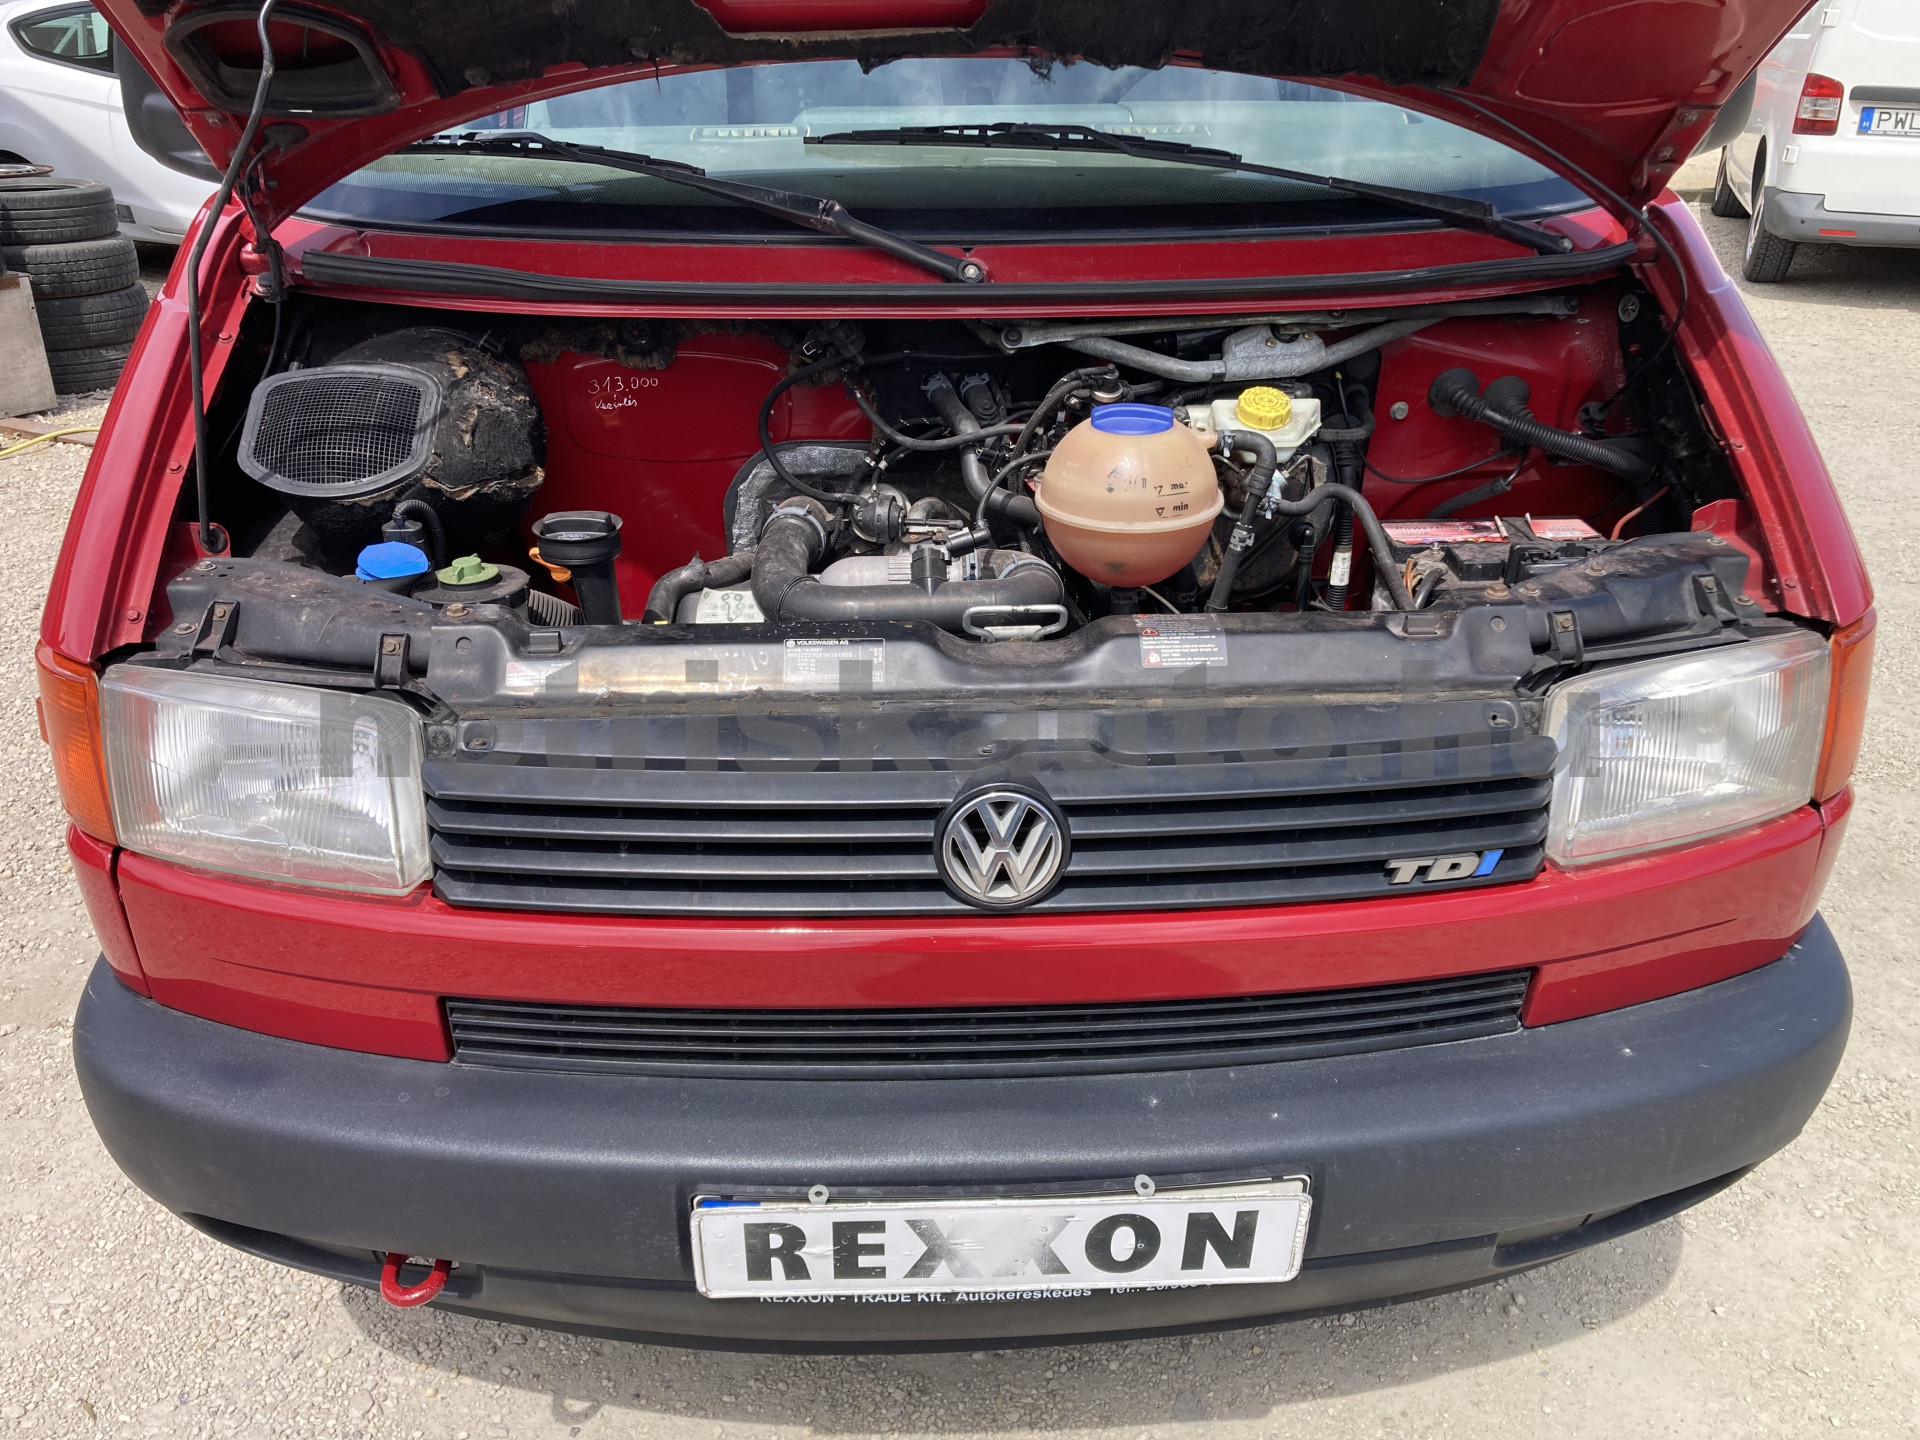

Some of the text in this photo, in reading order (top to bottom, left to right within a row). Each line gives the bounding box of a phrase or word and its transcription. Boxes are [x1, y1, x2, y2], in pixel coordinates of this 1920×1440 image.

[587, 376, 659, 395] 313.000
[1170, 482, 1188, 491] ma
[1173, 502, 1189, 512] min
[1384, 849, 1505, 885] TDI
[743, 1209, 1260, 1282] REXXON
